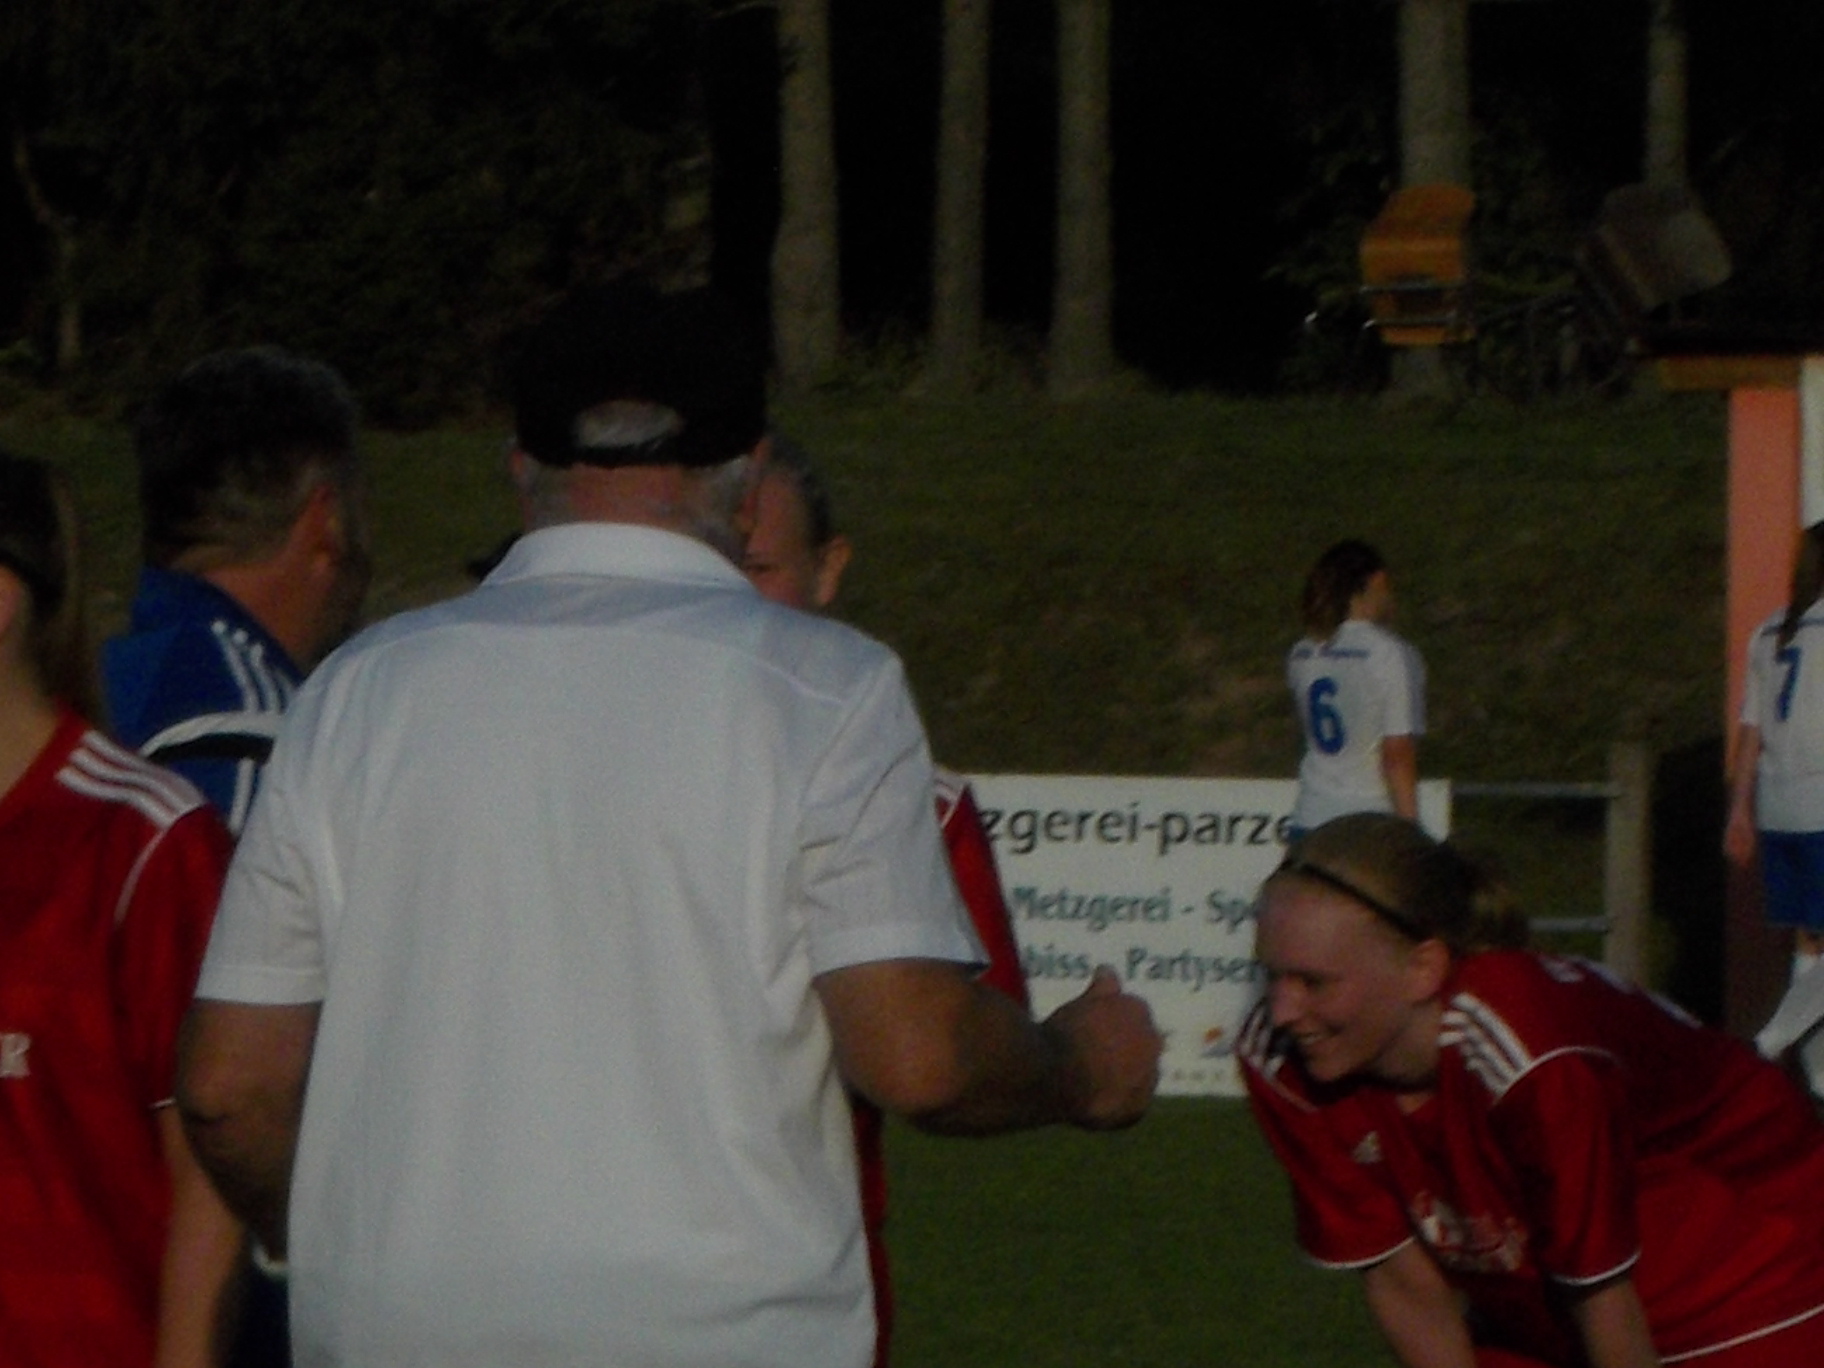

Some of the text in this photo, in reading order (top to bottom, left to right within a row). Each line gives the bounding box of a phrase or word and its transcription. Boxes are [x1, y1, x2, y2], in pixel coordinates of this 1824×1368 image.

[1309, 676, 1345, 756] 6
[1776, 646, 1802, 722] 7
[1013, 886, 1172, 932] Metzgerei
